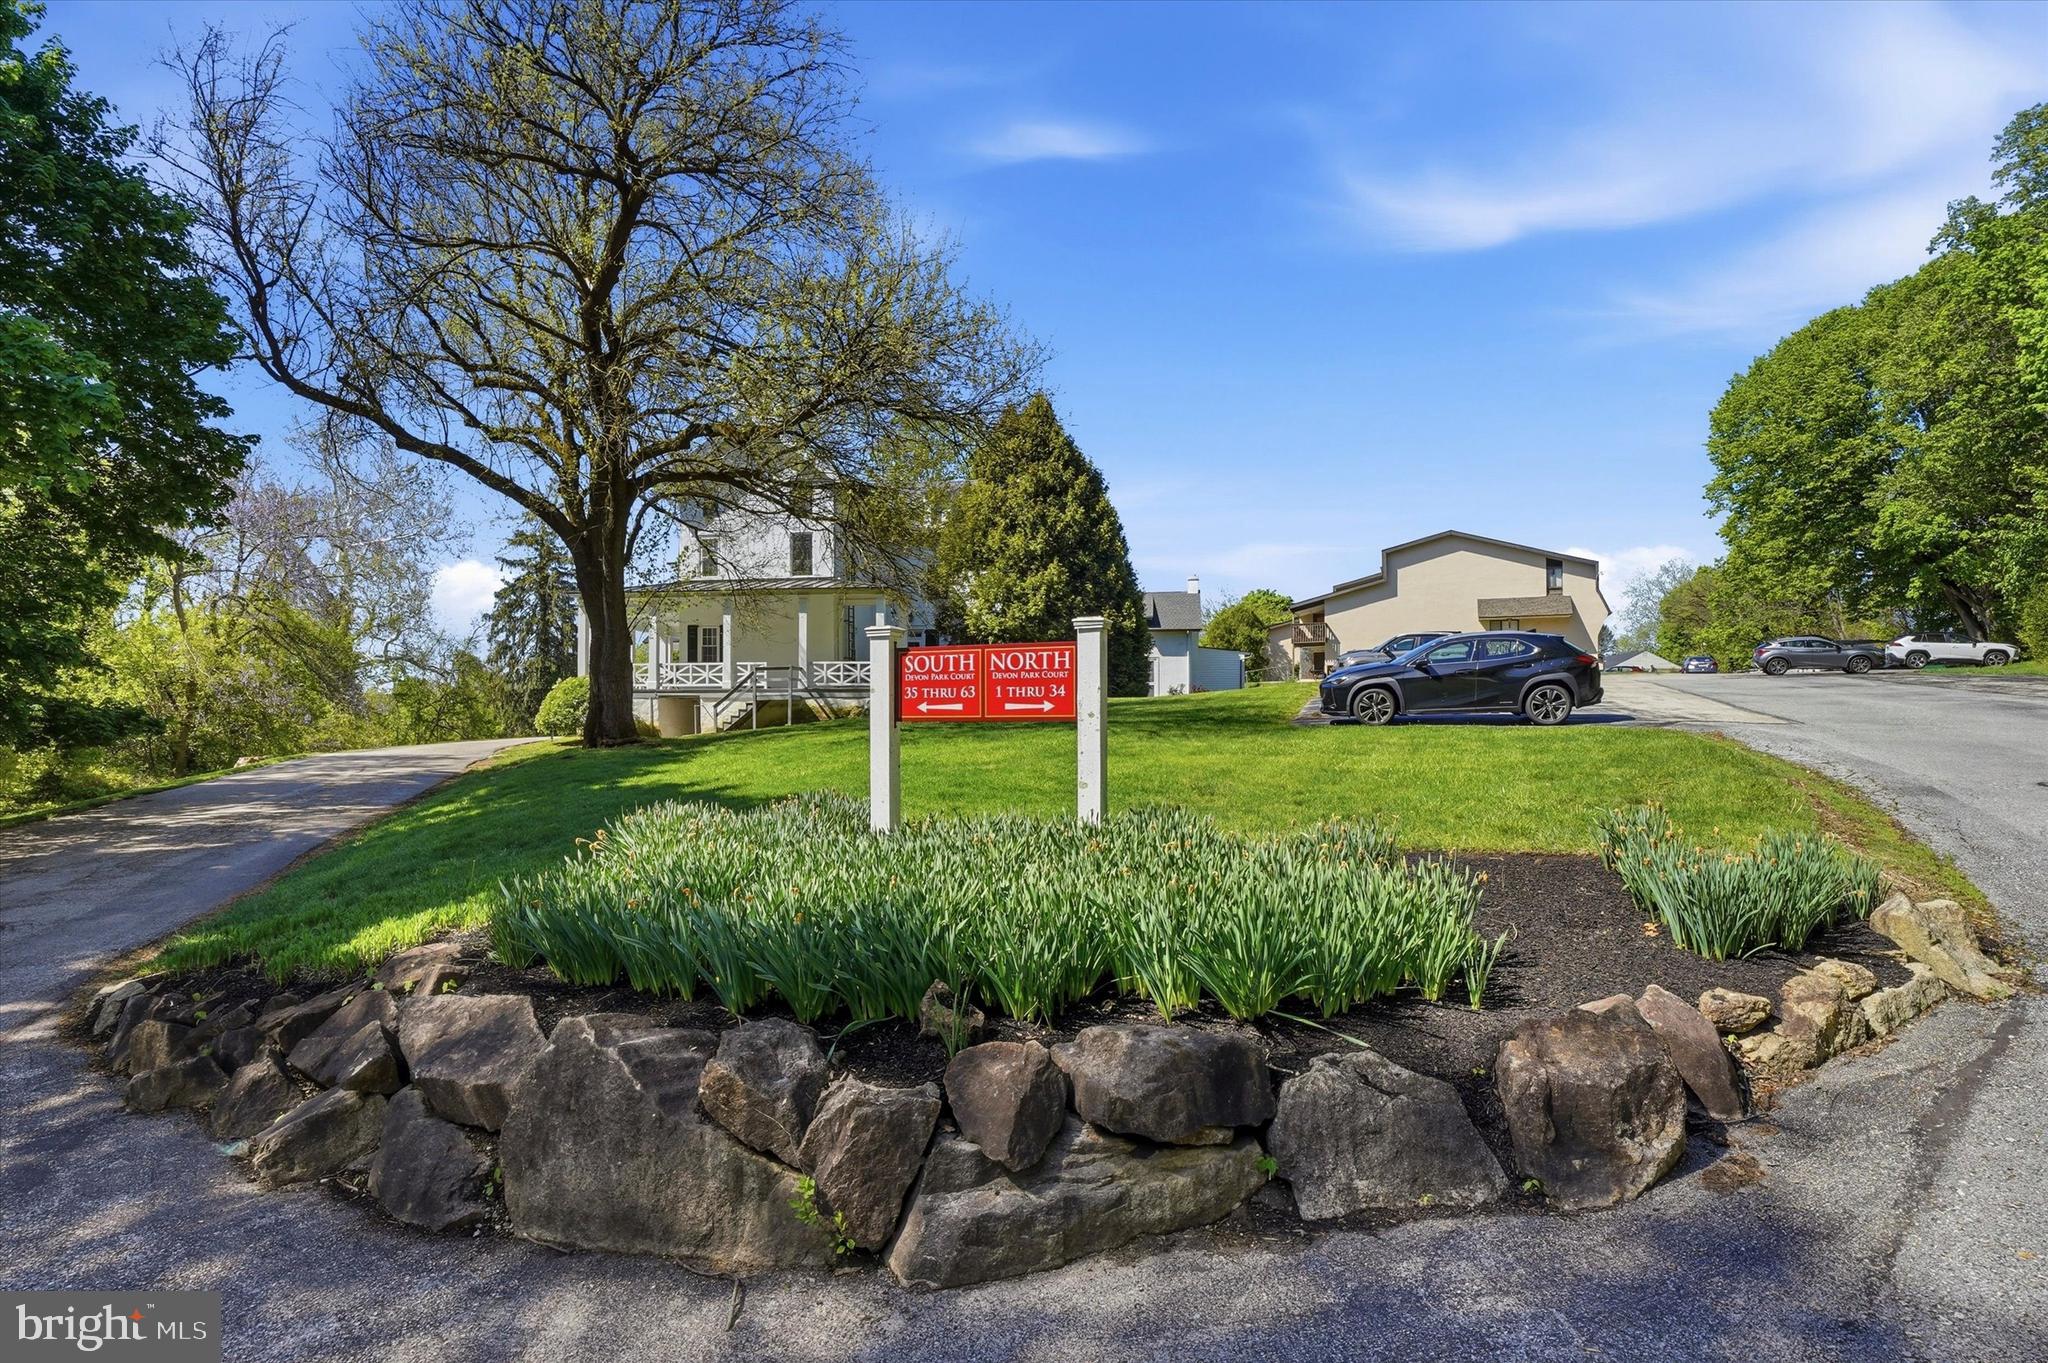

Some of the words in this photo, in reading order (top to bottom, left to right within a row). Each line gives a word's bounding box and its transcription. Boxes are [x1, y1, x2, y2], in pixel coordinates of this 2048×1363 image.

[905, 653, 975, 673] SOUTH
[990, 651, 1071, 671] NORTH
[1021, 671, 1040, 679] PARK
[904, 687, 918, 698] 35
[922, 687, 957, 698] THRU
[961, 686, 976, 697] 63
[996, 686, 1002, 697] 1
[1007, 686, 1044, 698] THRU
[1049, 685, 1066, 697] 34
